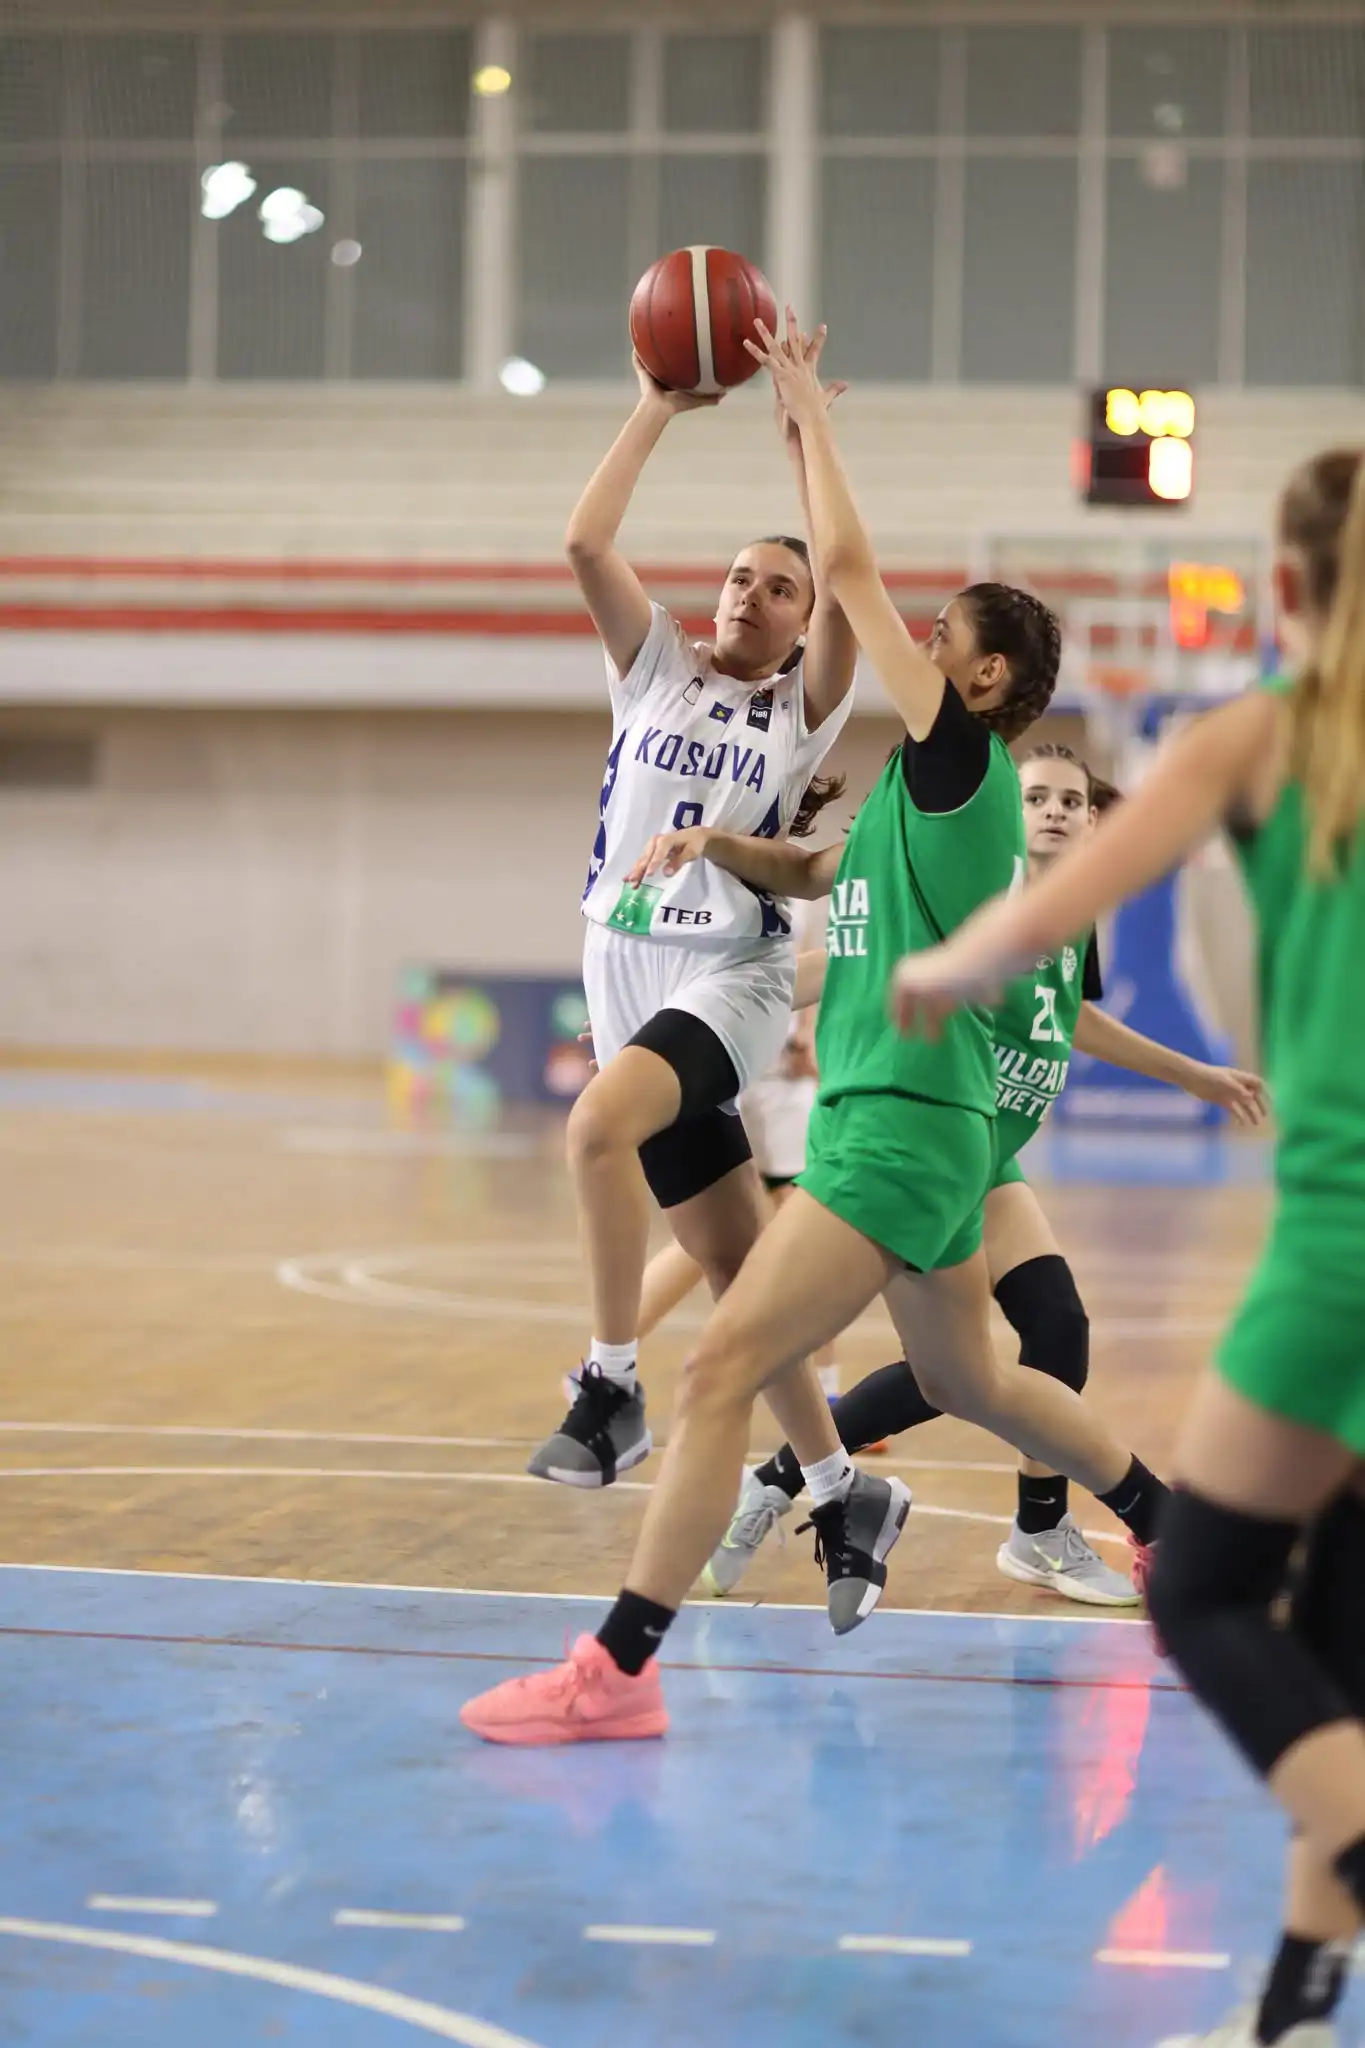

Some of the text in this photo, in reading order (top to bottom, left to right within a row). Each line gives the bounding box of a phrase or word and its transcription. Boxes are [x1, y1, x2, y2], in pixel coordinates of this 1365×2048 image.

[751, 708, 768, 720] FIBA
[635, 726, 766, 793] KOSOVA
[660, 906, 712, 925] TEB
